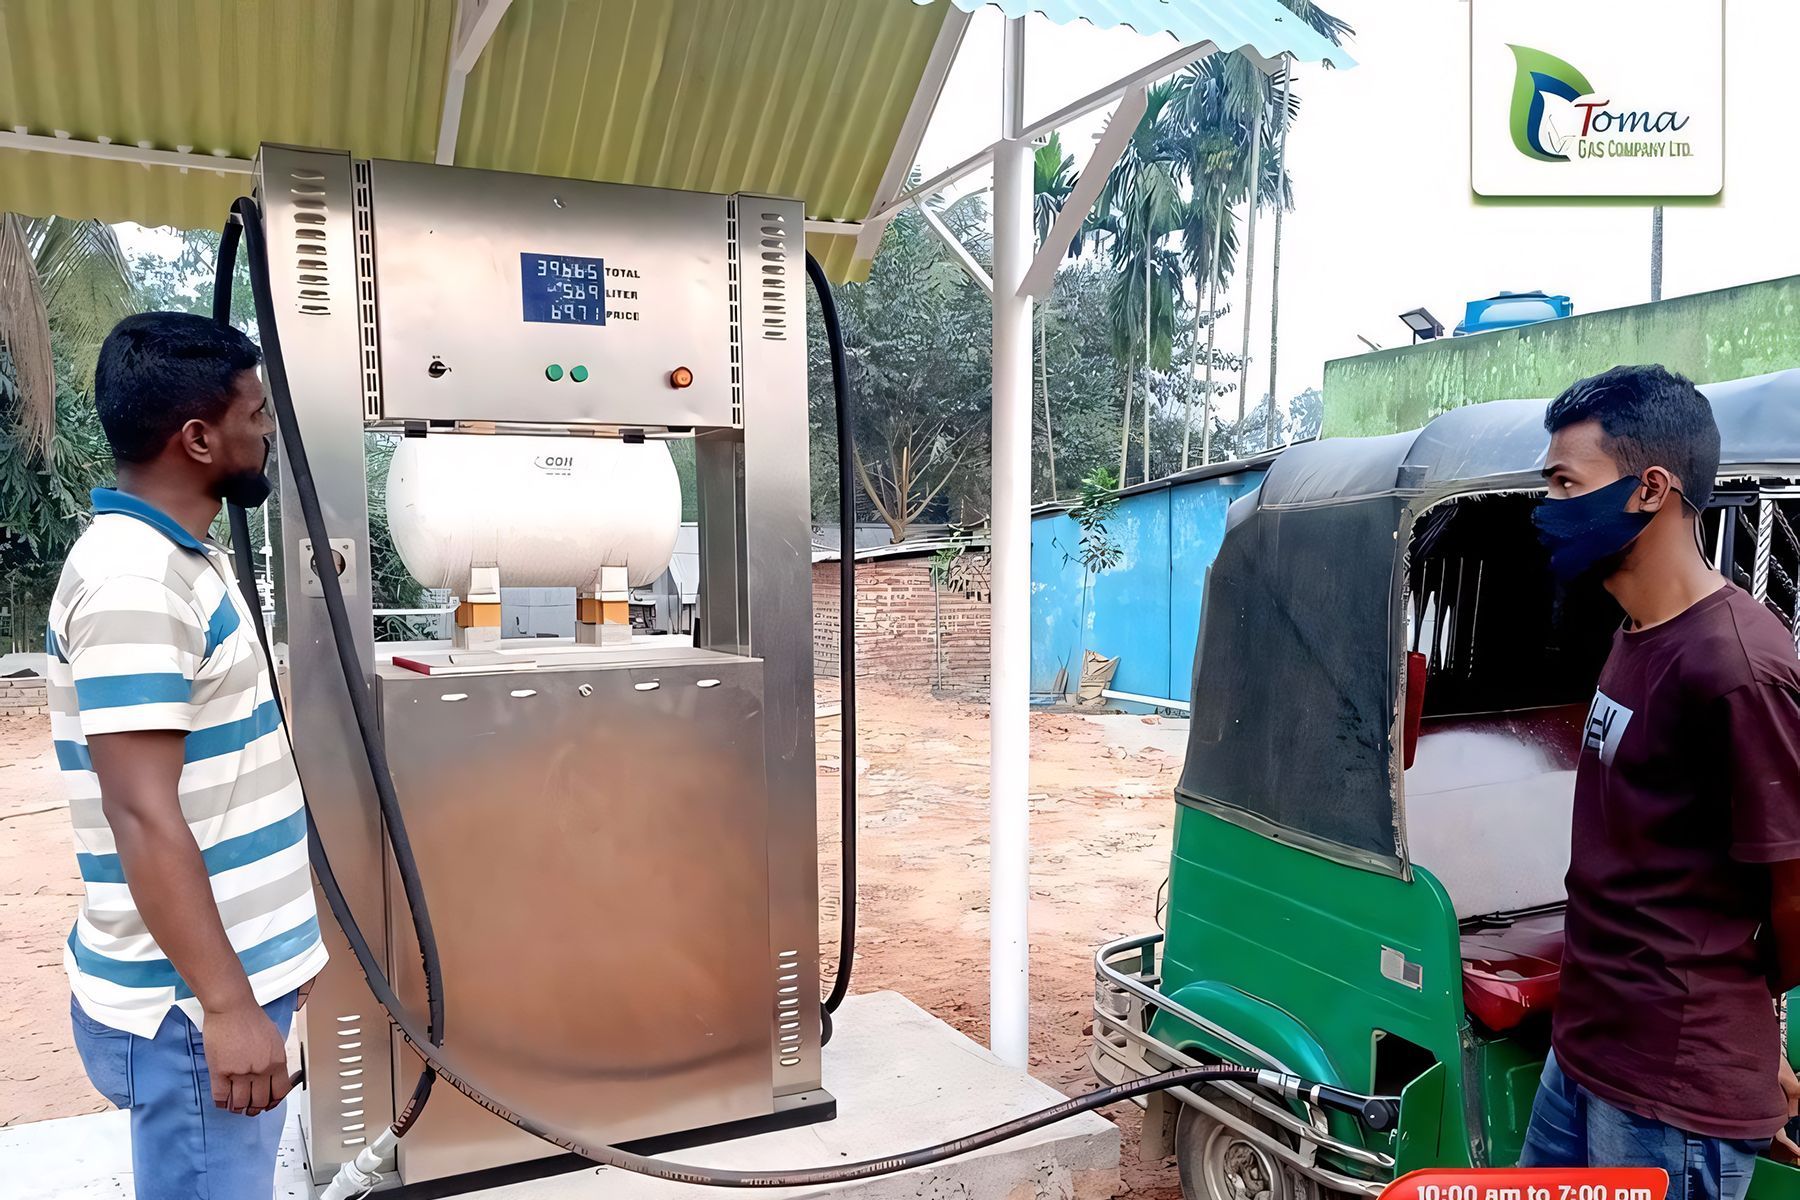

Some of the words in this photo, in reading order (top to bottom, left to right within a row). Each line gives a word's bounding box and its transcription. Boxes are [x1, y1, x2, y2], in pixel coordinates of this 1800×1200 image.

[605, 267, 641, 279] TOTAL
[605, 289, 638, 300] LITER
[606, 310, 640, 321] PRICE
